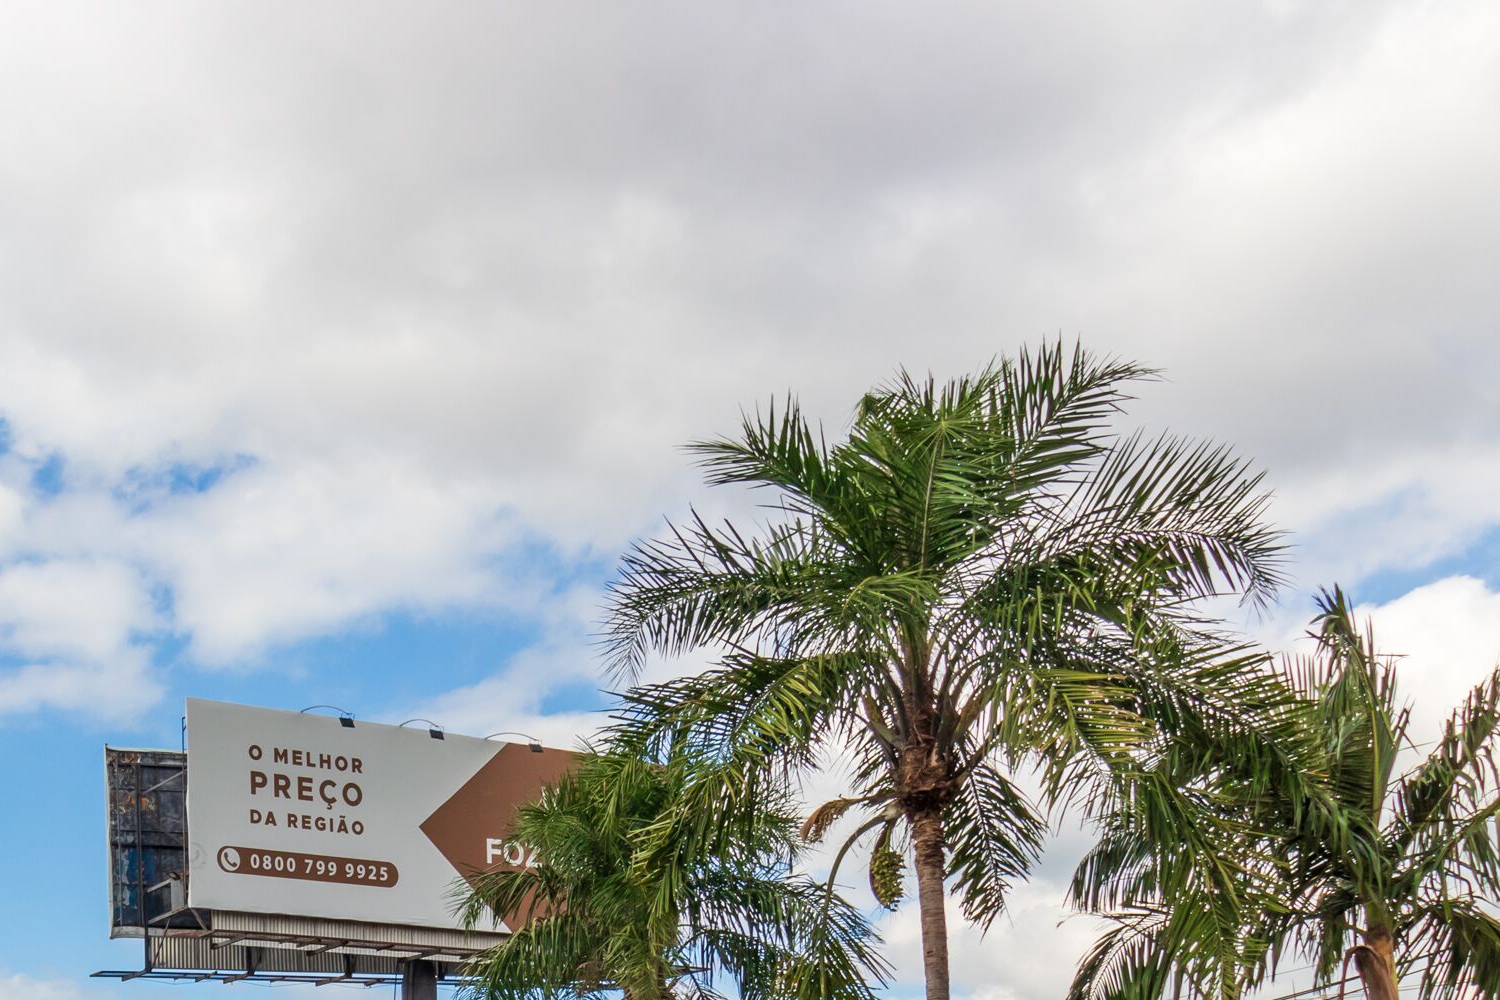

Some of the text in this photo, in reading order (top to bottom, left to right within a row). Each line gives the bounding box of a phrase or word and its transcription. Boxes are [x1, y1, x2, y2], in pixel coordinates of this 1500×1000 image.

[248, 744, 363, 774] O MELHOR
[250, 770, 363, 810] PREÇO
[249, 809, 364, 836] DA REGIÃO
[250, 853, 388, 881] 0800 799 9925
[485, 838, 542, 868] FOZ
